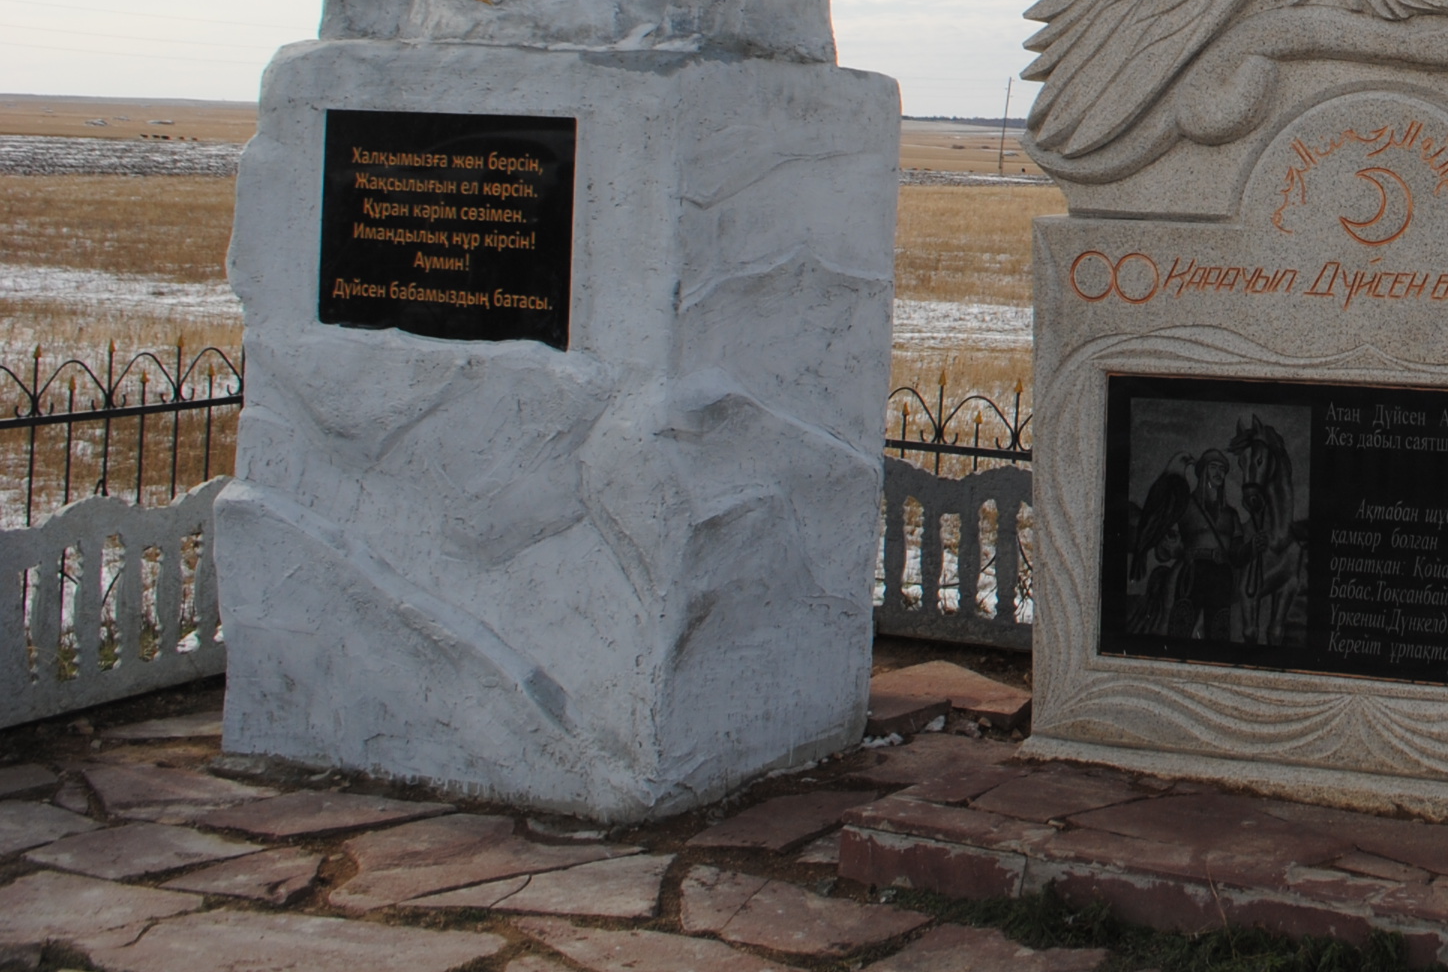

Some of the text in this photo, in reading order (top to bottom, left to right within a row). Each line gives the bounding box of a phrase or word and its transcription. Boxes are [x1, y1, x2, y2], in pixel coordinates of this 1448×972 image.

[351, 146, 544, 176] Халқымызға жөн берсін,
[354, 172, 538, 200] Жақсылығын ел көрсін.
[363, 197, 527, 223] Құран кәрім сөзімен.
[353, 222, 536, 252] Имандылық нұр кірсін!
[413, 251, 470, 273] Аумин!
[333, 278, 553, 310] Дүйсен бабамыздың батасы.
[1325, 401, 1360, 425] Атаң
[1372, 403, 1426, 429] Дүйсен
[1325, 426, 1354, 447] Жез
[1357, 429, 1401, 450] дабыл
[1355, 499, 1419, 523] Ақтабан
[1330, 527, 1382, 553] қамқор
[1328, 630, 1382, 658] Керейт
